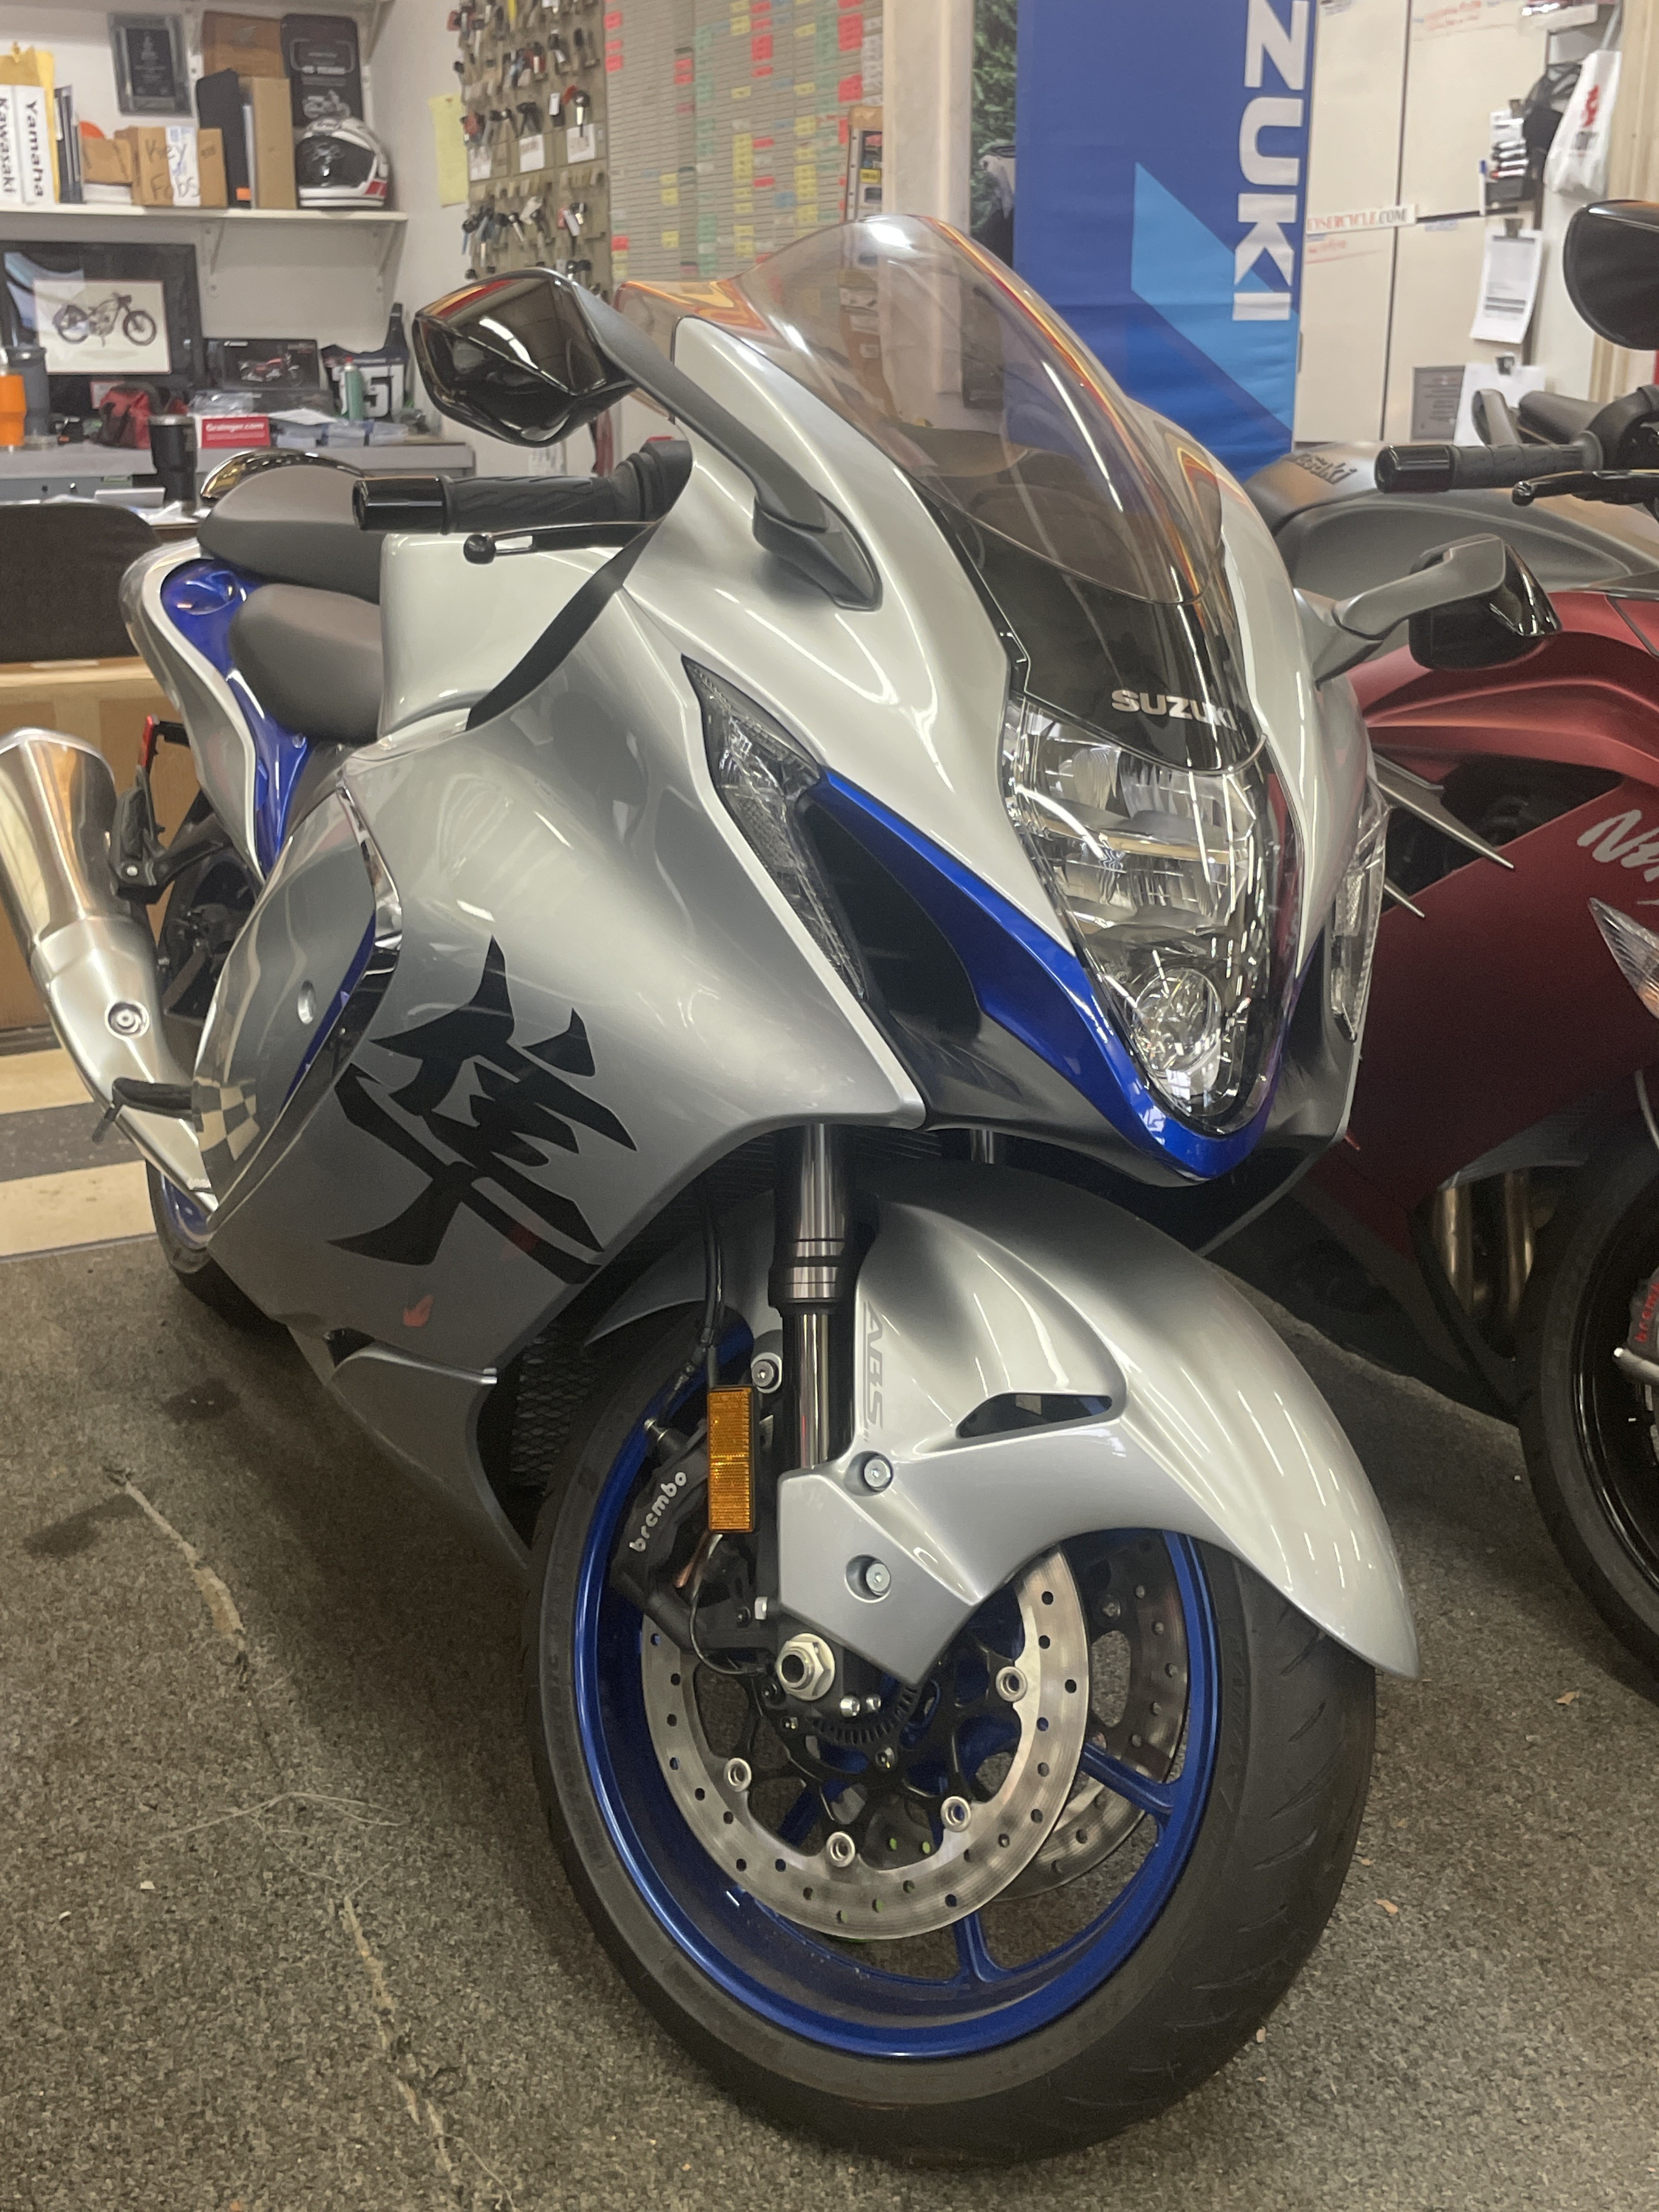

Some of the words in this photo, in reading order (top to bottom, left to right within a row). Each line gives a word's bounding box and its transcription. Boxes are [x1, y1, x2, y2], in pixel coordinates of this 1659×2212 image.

[25, 100, 44, 198] Yamaha
[144, 139, 188, 167] Key
[867, 1300, 883, 1430] ABS
[629, 1471, 687, 1552] brembo
